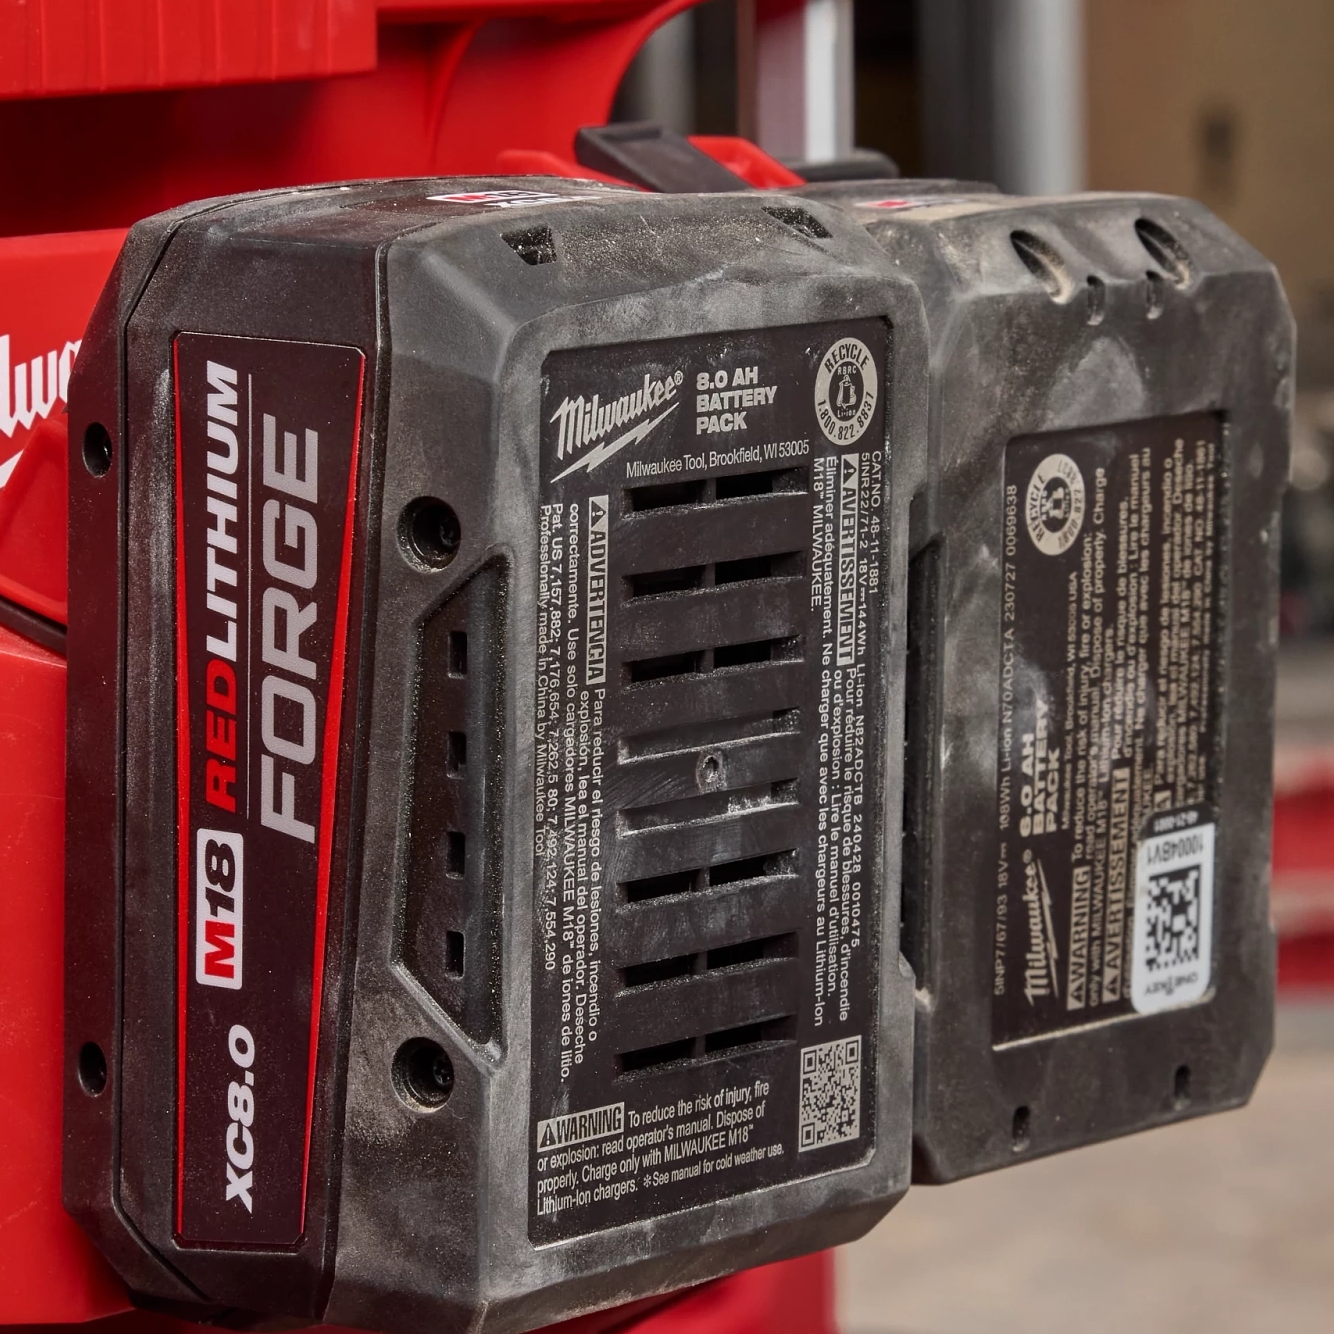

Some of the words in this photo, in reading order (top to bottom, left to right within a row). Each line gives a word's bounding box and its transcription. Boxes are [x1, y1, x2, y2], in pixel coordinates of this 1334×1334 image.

[696, 370, 728, 391] 8.0
[732, 366, 759, 387] AH
[824, 343, 870, 374] RECYCLE
[837, 365, 857, 375] RBRC
[696, 385, 778, 413] BATTERY
[696, 411, 748, 435] PACK
[626, 457, 683, 478] Milwaukee
[683, 453, 708, 471] Tool,
[709, 445, 763, 468] Brookfield,
[763, 443, 778, 460] WI
[778, 439, 810, 458] 53005
[825, 455, 839, 519] Éliminer
[1092, 467, 1107, 525] Charge
[552, 503, 563, 532] Pat.
[1005, 485, 1017, 556] 0069638
[537, 504, 552, 609] Professionally
[551, 537, 563, 560] US
[567, 503, 581, 623] correctamente.
[811, 504, 824, 612] MILWAUKEE.
[838, 488, 857, 659] AVERTISSEMENT
[868, 515, 880, 594] 48-11-1881
[205, 359, 238, 813] REDLITHIUM
[587, 531, 606, 681] ADVERTENCIA
[822, 523, 835, 639] adéquatement.
[1004, 563, 1016, 621] 230727
[260, 413, 319, 844] FORGE
[538, 612, 549, 654] made
[567, 628, 579, 660] Use
[821, 643, 833, 666] Ne
[538, 658, 549, 671] in
[566, 665, 578, 698] solo
[833, 670, 842, 689] ou
[845, 667, 857, 704] Pour
[855, 663, 866, 708] Li-ion
[537, 675, 549, 719] China
[593, 688, 606, 726] Para
[818, 670, 832, 729] charger
[534, 723, 547, 740] by
[563, 703, 577, 792] cargadores
[577, 690, 591, 771] explosión,
[592, 730, 604, 785] reducir
[818, 733, 829, 762] que
[830, 693, 844, 780] d'explosion
[844, 708, 856, 763] réduire
[1021, 733, 1035, 777] AH
[535, 745, 547, 822] Milwaukee
[578, 775, 590, 799] lea
[818, 767, 828, 804] avec
[843, 767, 854, 781] le
[853, 715, 865, 805] N82ADCTB
[1032, 699, 1049, 835] BATTERY
[578, 804, 589, 819] el
[592, 790, 603, 804] el
[830, 793, 842, 823] Lire
[841, 785, 854, 833] risque
[1045, 747, 1060, 833] PACK
[535, 825, 546, 856] Tool
[588, 808, 603, 857] riesgo
[818, 808, 829, 831] les
[830, 827, 841, 842] le
[842, 837, 853, 857] de
[852, 814, 863, 873] 240428
[563, 797, 576, 902] MILWAUKEE
[577, 823, 589, 881] manual
[591, 861, 602, 882] de
[815, 835, 829, 913] chargeurs
[829, 845, 840, 903] manuel
[1071, 843, 1083, 863] To
[1105, 776, 1128, 969] AVERTISSEMENT
[204, 838, 236, 980] M18
[576, 886, 588, 910] del
[588, 886, 602, 956] lesiones,
[839, 860, 853, 939] blessures,
[851, 881, 861, 948] 0010475
[544, 897, 557, 971] 7,554,290
[574, 914, 587, 989] operador.
[816, 917, 825, 936] au
[827, 906, 839, 997] d'utilisation.
[1071, 869, 1090, 986] WARNING
[562, 954, 573, 974] de
[814, 940, 827, 1027] Lithium-Ion
[839, 943, 851, 1022] d'incendie
[561, 979, 573, 1022] iones
[588, 960, 601, 1027] incendio
[561, 1025, 572, 1046] de
[574, 993, 587, 1064] Deseche
[588, 1031, 597, 1041] o
[560, 1049, 572, 1083] litio.
[225, 1024, 255, 1214] XC8.0
[537, 1158, 549, 1172] or
[550, 1144, 600, 1172] explosion:
[601, 1134, 624, 1157] read
[626, 1124, 674, 1153] operator's
[676, 1113, 713, 1139] manual.
[716, 1107, 753, 1129] Dispose
[755, 1100, 766, 1117] of
[556, 1106, 622, 1144] WARNING
[627, 1110, 640, 1128] To
[642, 1105, 675, 1126] reduce
[677, 1099, 693, 1116] the
[695, 1093, 712, 1112] risk
[713, 1089, 724, 1107] of
[725, 1086, 752, 1107] injury,
[754, 1080, 769, 1098] fire
[537, 1169, 579, 1198] properly.
[581, 1162, 617, 1183] Charge
[619, 1150, 641, 1175] only
[642, 1147, 662, 1168] with
[664, 1131, 726, 1163] MILWAUKEE
[593, 1177, 638, 1201] chargers.
[671, 1161, 701, 1182] manual
[702, 1159, 714, 1174] for
[716, 1152, 733, 1170] cold
[734, 1147, 766, 1166] weather
[768, 1143, 784, 1158] use.
